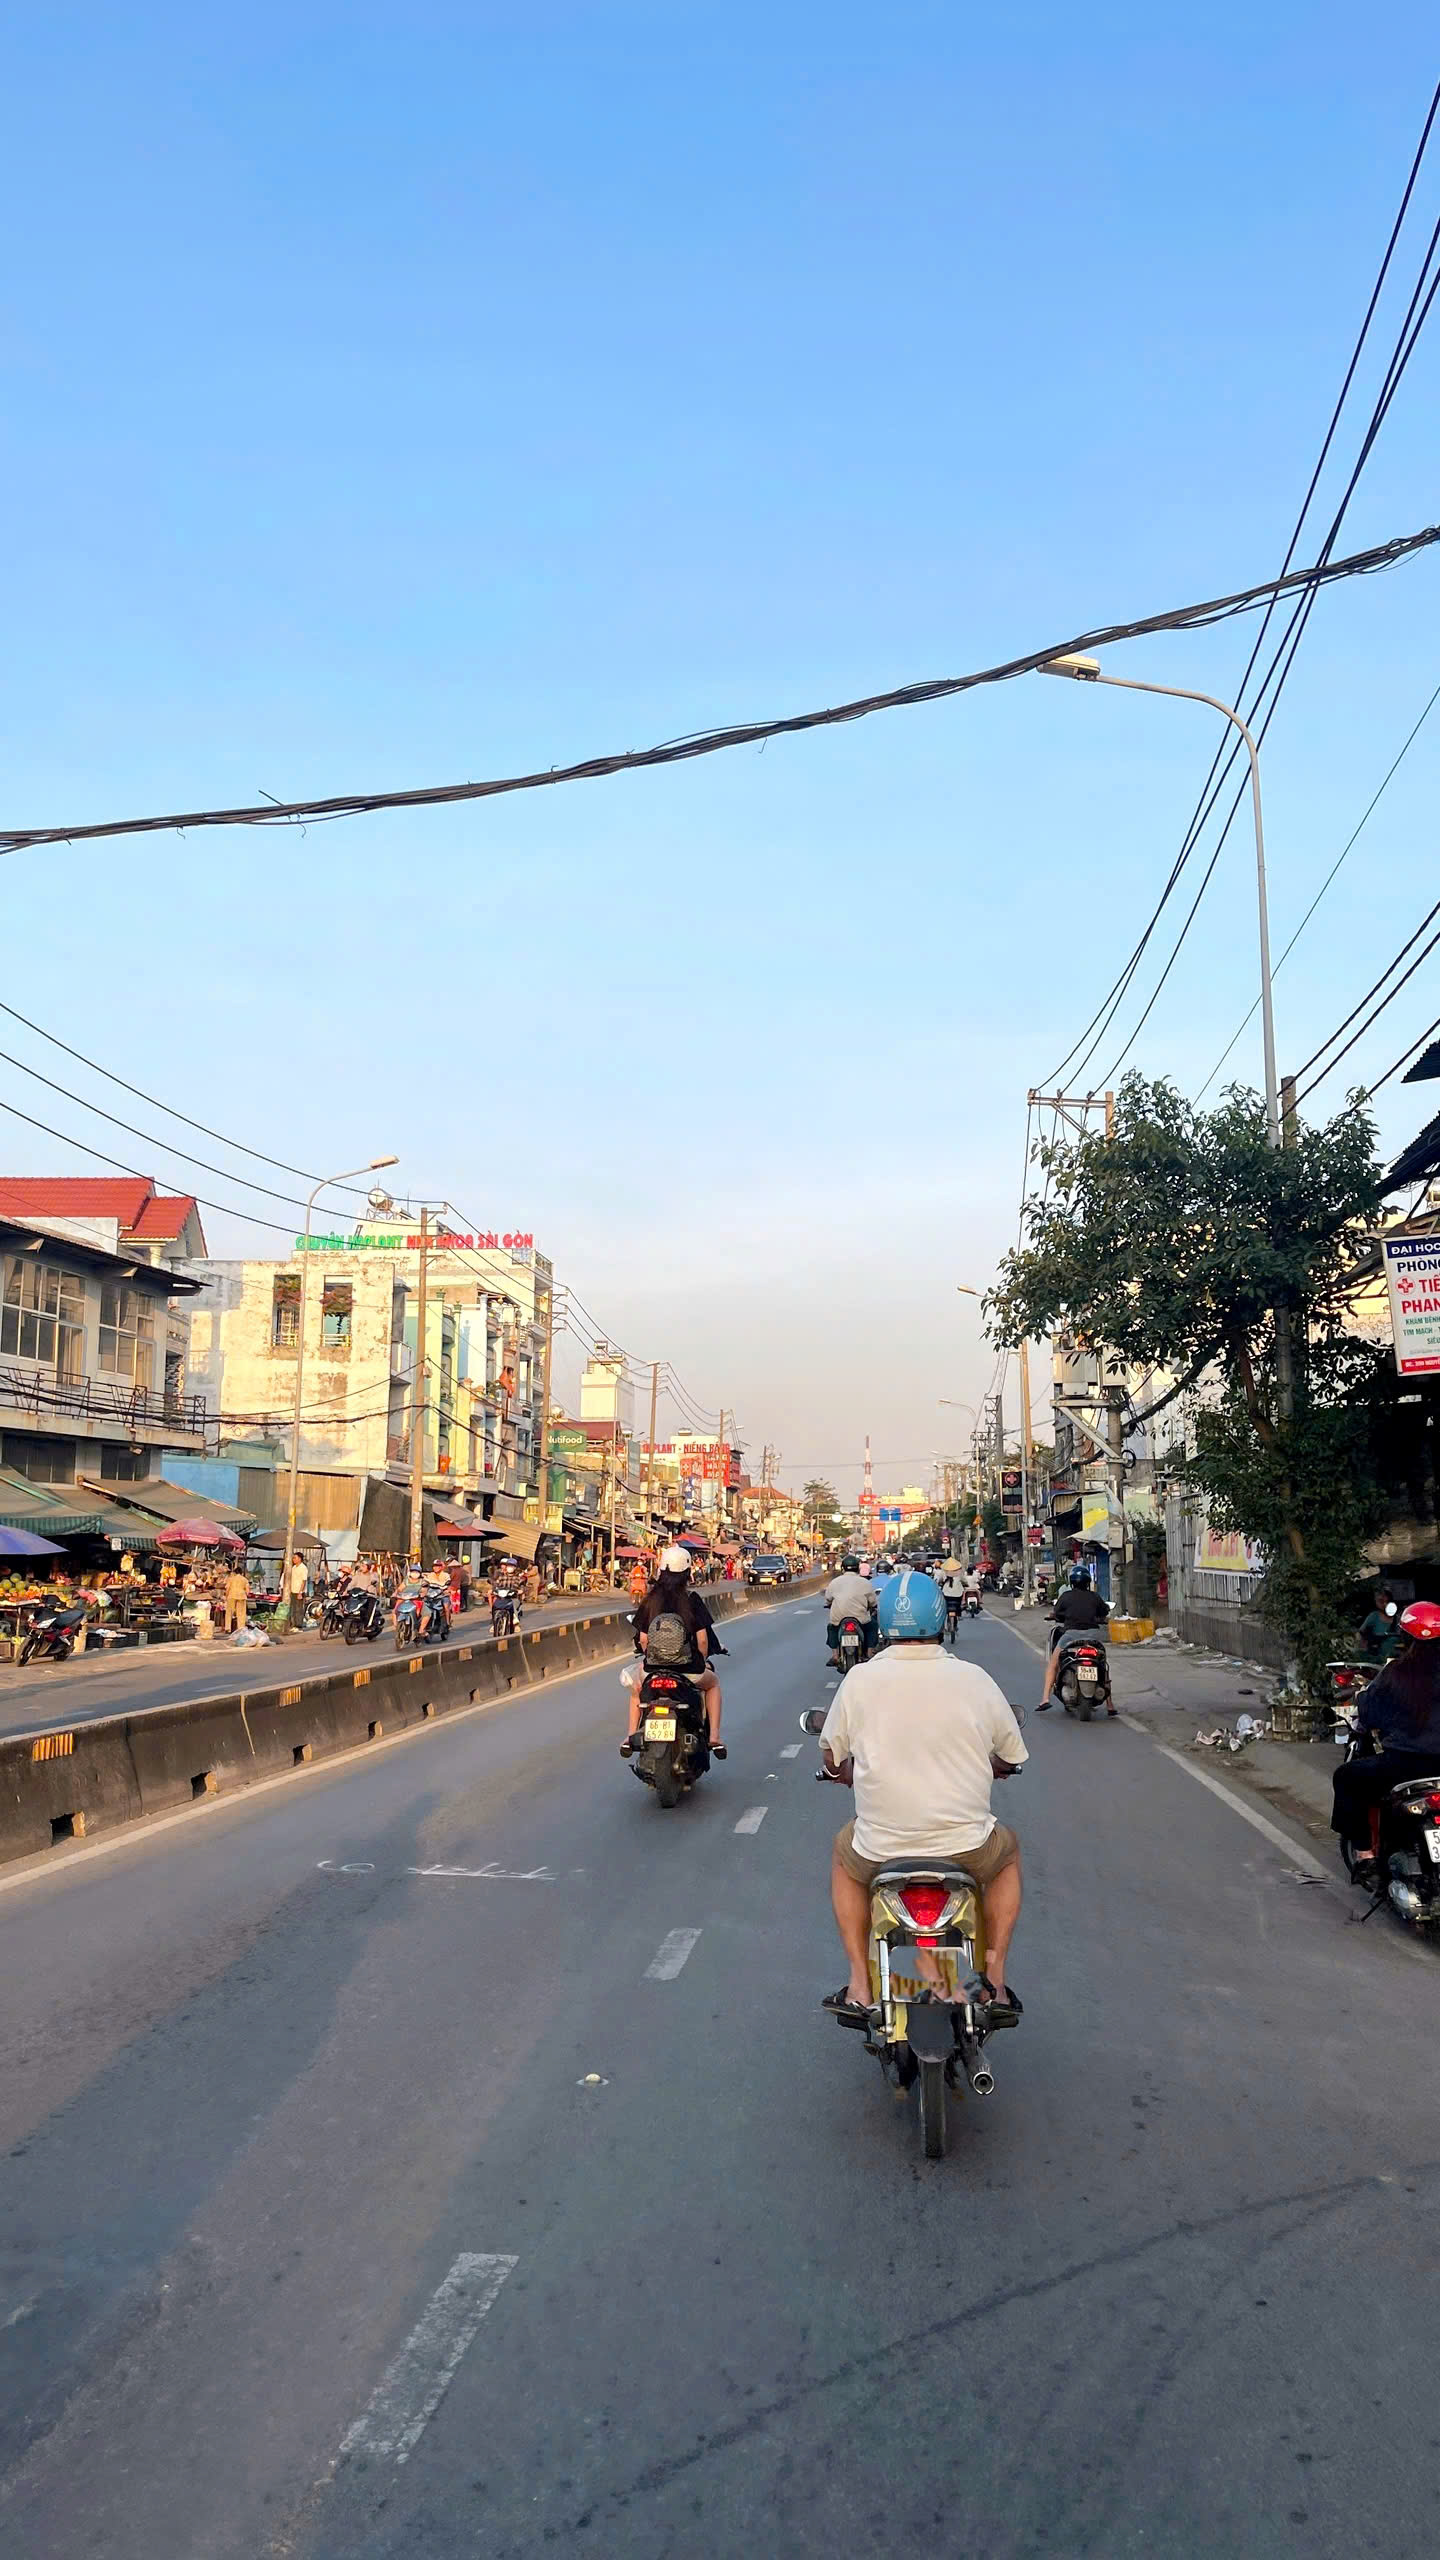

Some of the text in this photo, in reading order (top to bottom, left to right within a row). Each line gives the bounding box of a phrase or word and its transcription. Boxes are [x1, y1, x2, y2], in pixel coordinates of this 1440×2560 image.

[348, 1235, 403, 1250] IMPLANT
[478, 1230, 498, 1249] SÀI
[503, 1229, 533, 1249] GÒN
[1391, 1242, 1440, 1255] ĐẠI HỌC
[547, 1435, 583, 1443] Nutifood
